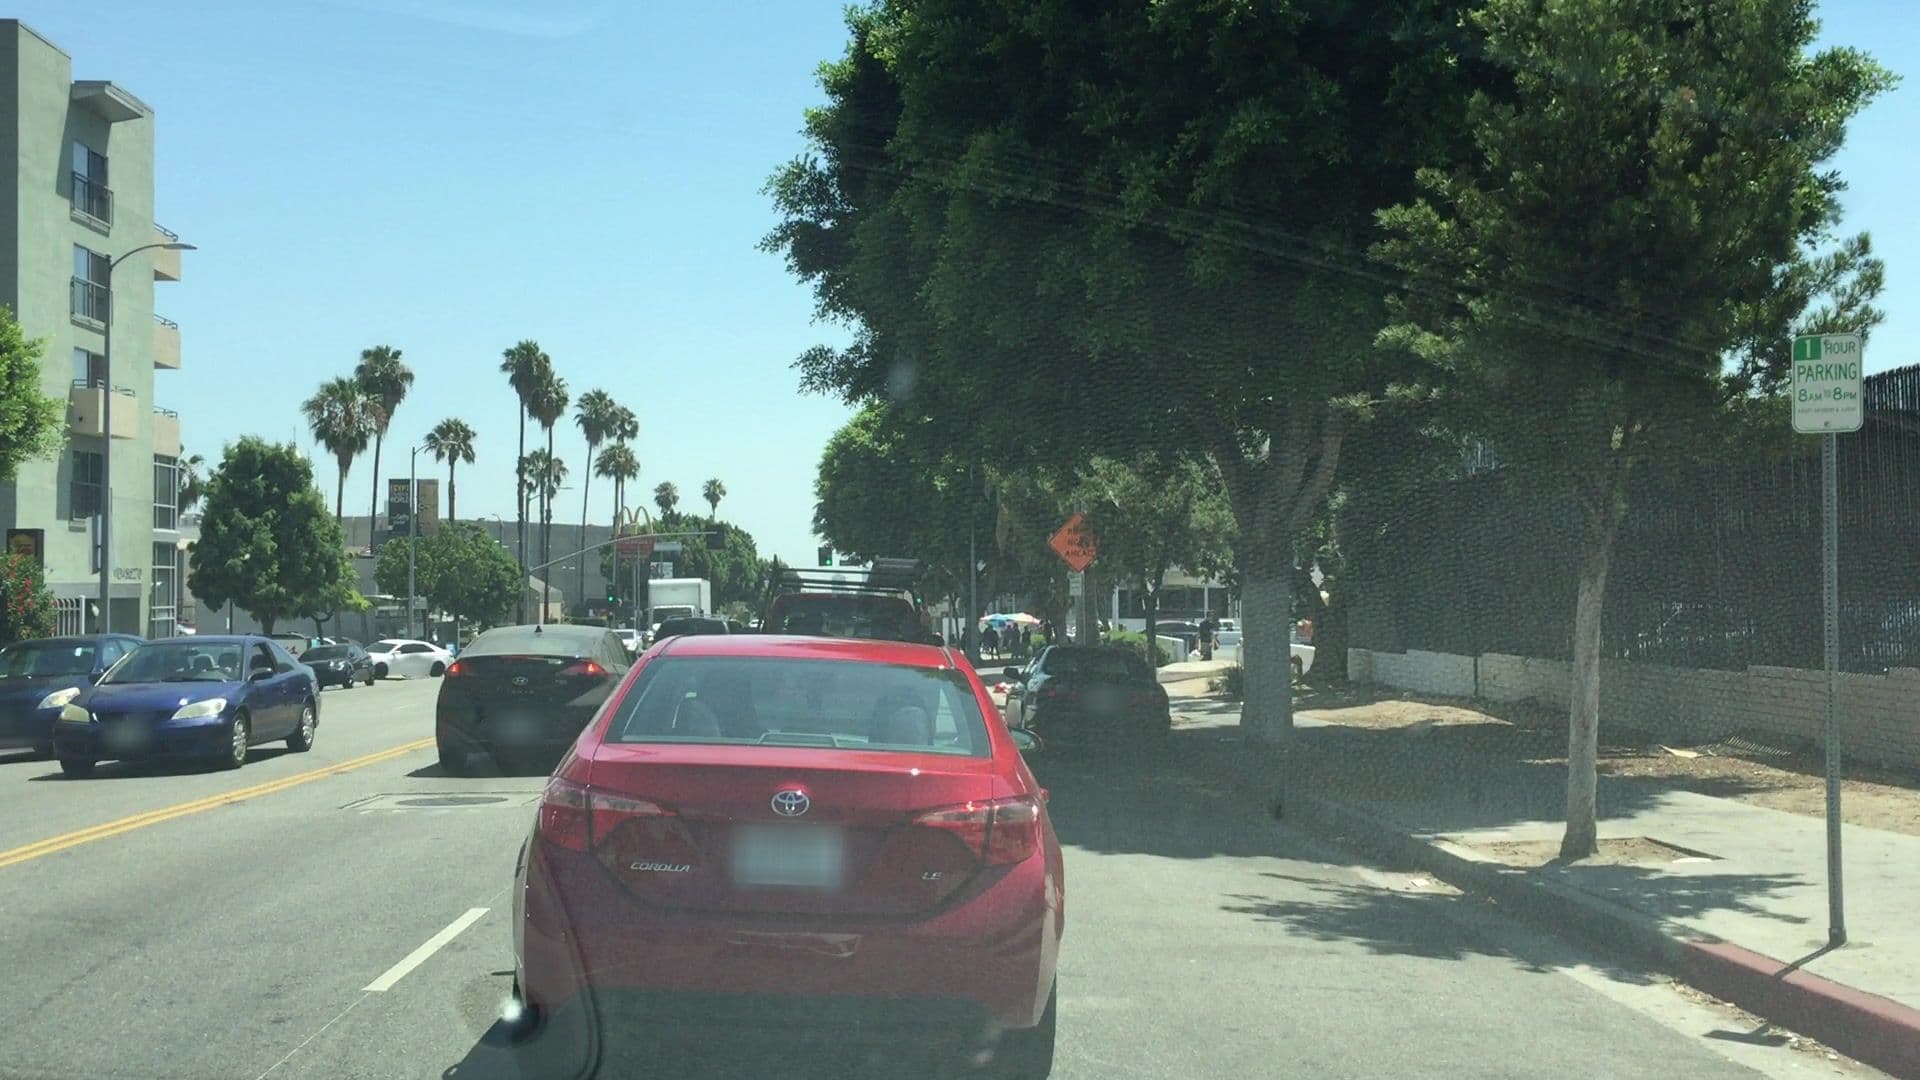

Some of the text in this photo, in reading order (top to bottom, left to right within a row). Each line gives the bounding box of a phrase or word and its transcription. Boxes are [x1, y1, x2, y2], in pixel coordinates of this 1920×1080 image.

[1805, 340, 1856, 359] 1 HOUR
[1797, 362, 1858, 382] PARKING
[630, 861, 692, 873] COROLLA
